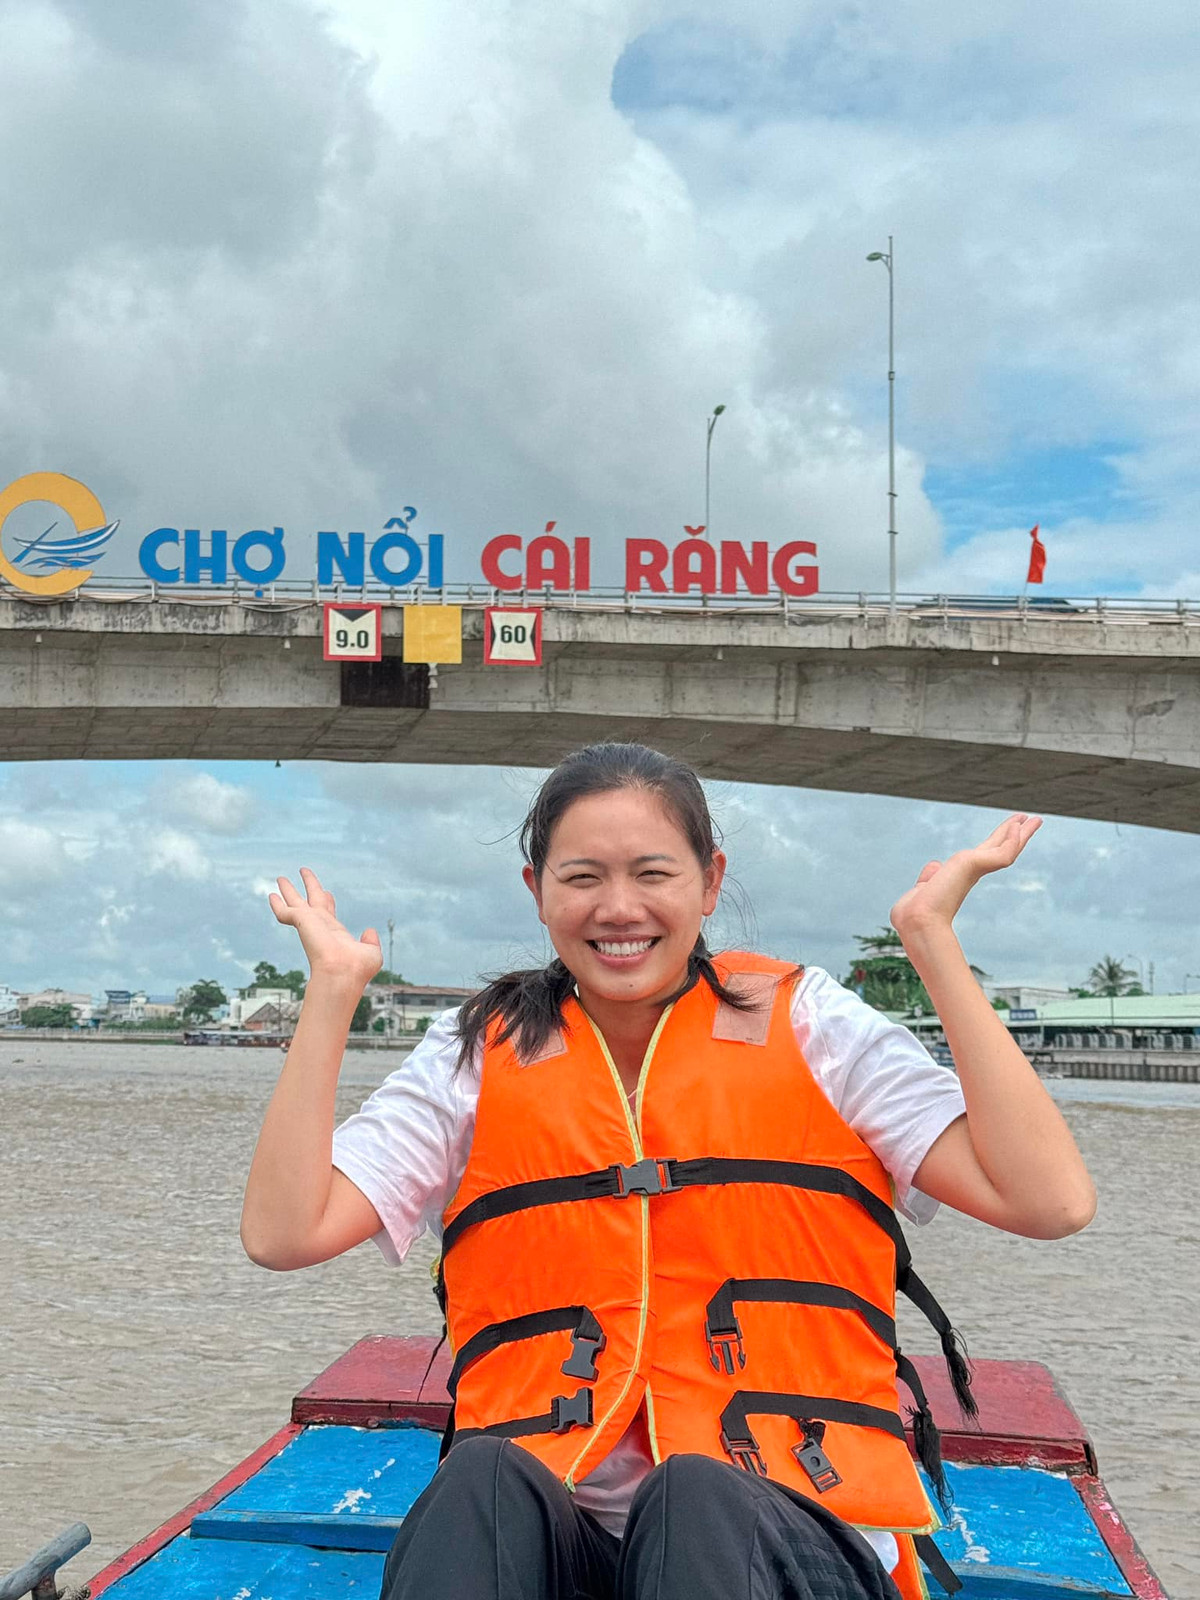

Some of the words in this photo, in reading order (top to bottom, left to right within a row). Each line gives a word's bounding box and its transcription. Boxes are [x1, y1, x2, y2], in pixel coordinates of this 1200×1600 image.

[139, 527, 286, 598] CHỢ
[317, 506, 444, 588] NỔI
[481, 521, 590, 591] CÁI
[625, 525, 819, 597] RĂNG
[335, 629, 370, 649] 9.0
[500, 625, 526, 644] 60
